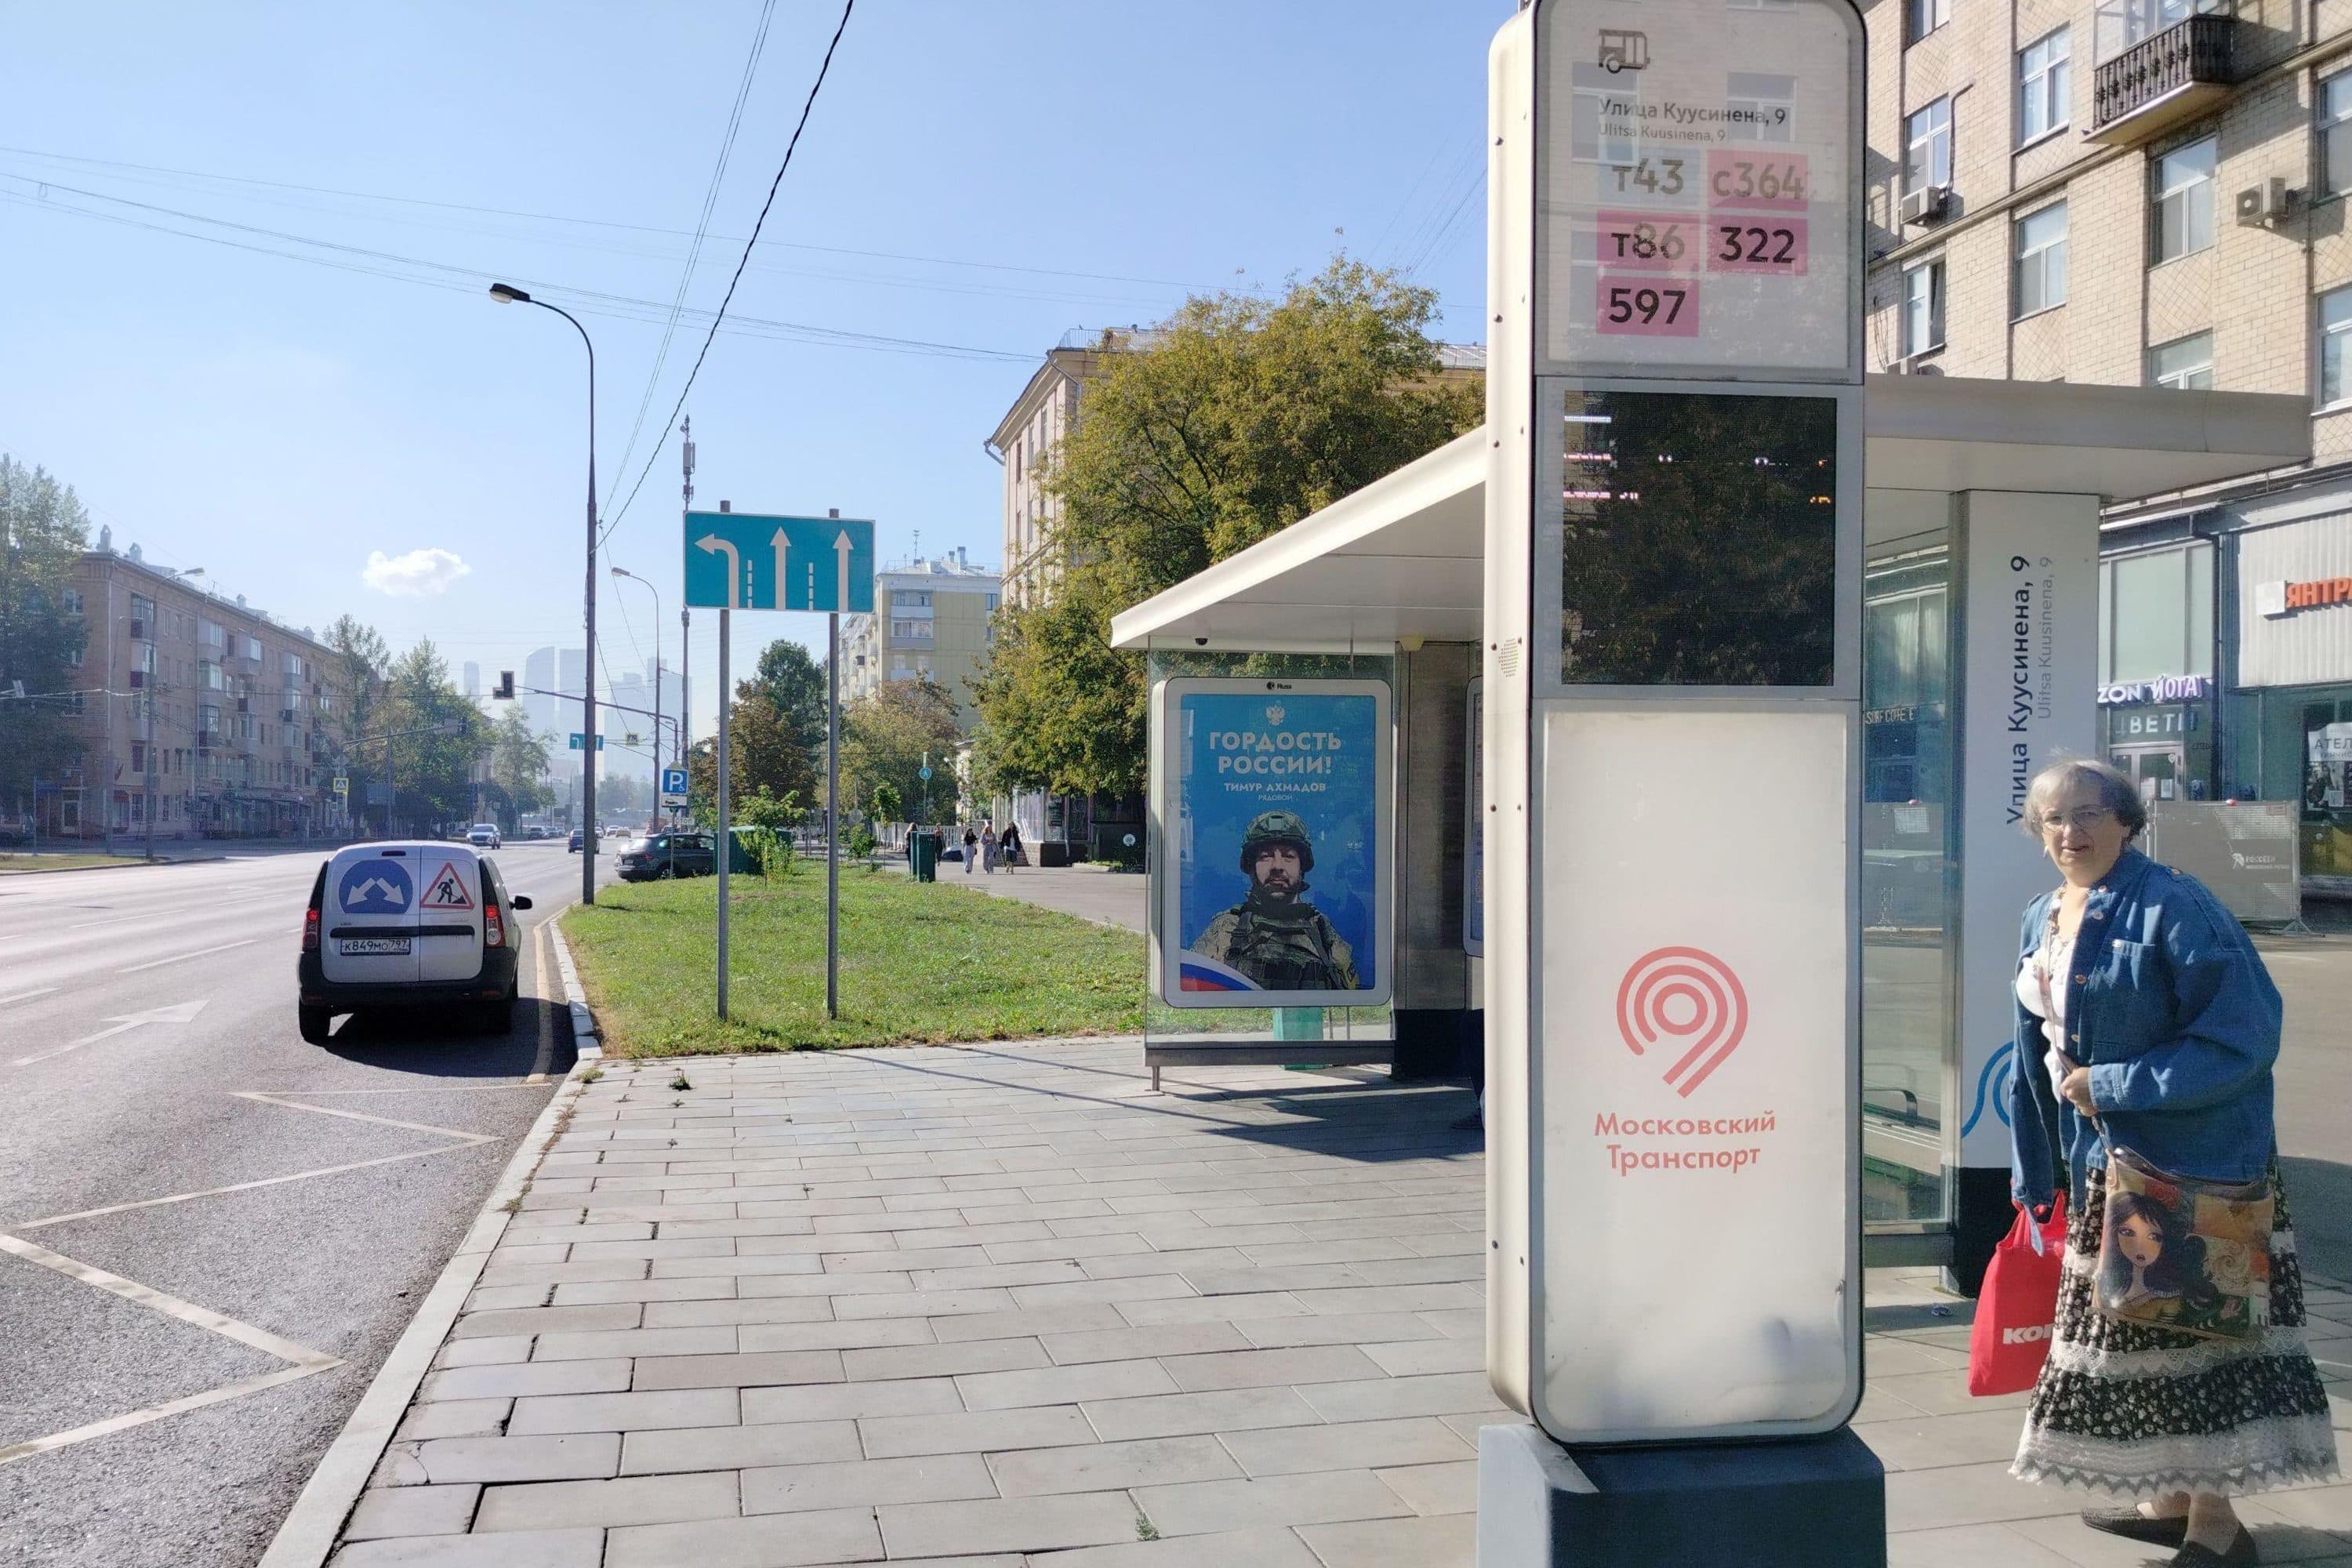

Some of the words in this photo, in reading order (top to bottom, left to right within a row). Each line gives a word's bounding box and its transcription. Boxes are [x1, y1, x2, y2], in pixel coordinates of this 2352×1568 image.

[1599, 99, 1657, 119] Улица
[1664, 102, 1770, 127] Куусинена,
[1774, 108, 1786, 125] 9
[1599, 123, 1637, 137] Ulitsa
[1640, 125, 1715, 143] Kuusinena,
[1717, 130, 1726, 141] 9
[1719, 226, 1795, 264] 322
[1608, 287, 1686, 325] 597
[2010, 555, 2031, 572] 9
[2040, 557, 2053, 568] 9
[2038, 574, 2055, 667] Kuusinena,
[2008, 581, 2034, 732] Куусинена,
[2038, 673, 2052, 719] Ulitsa
[2097, 684, 2142, 703] ZON
[1210, 731, 1341, 753] ГОРДОСТЬ
[1218, 756, 1331, 775] РОССИИ!
[670, 771, 684, 791] P
[1224, 782, 1262, 792] ТИМУР
[1265, 782, 1327, 793] АХМАДОВ
[2006, 742, 2030, 825] Улица
[1595, 1109, 1776, 1137] Московский
[1606, 1144, 1761, 1177] Транспорт
